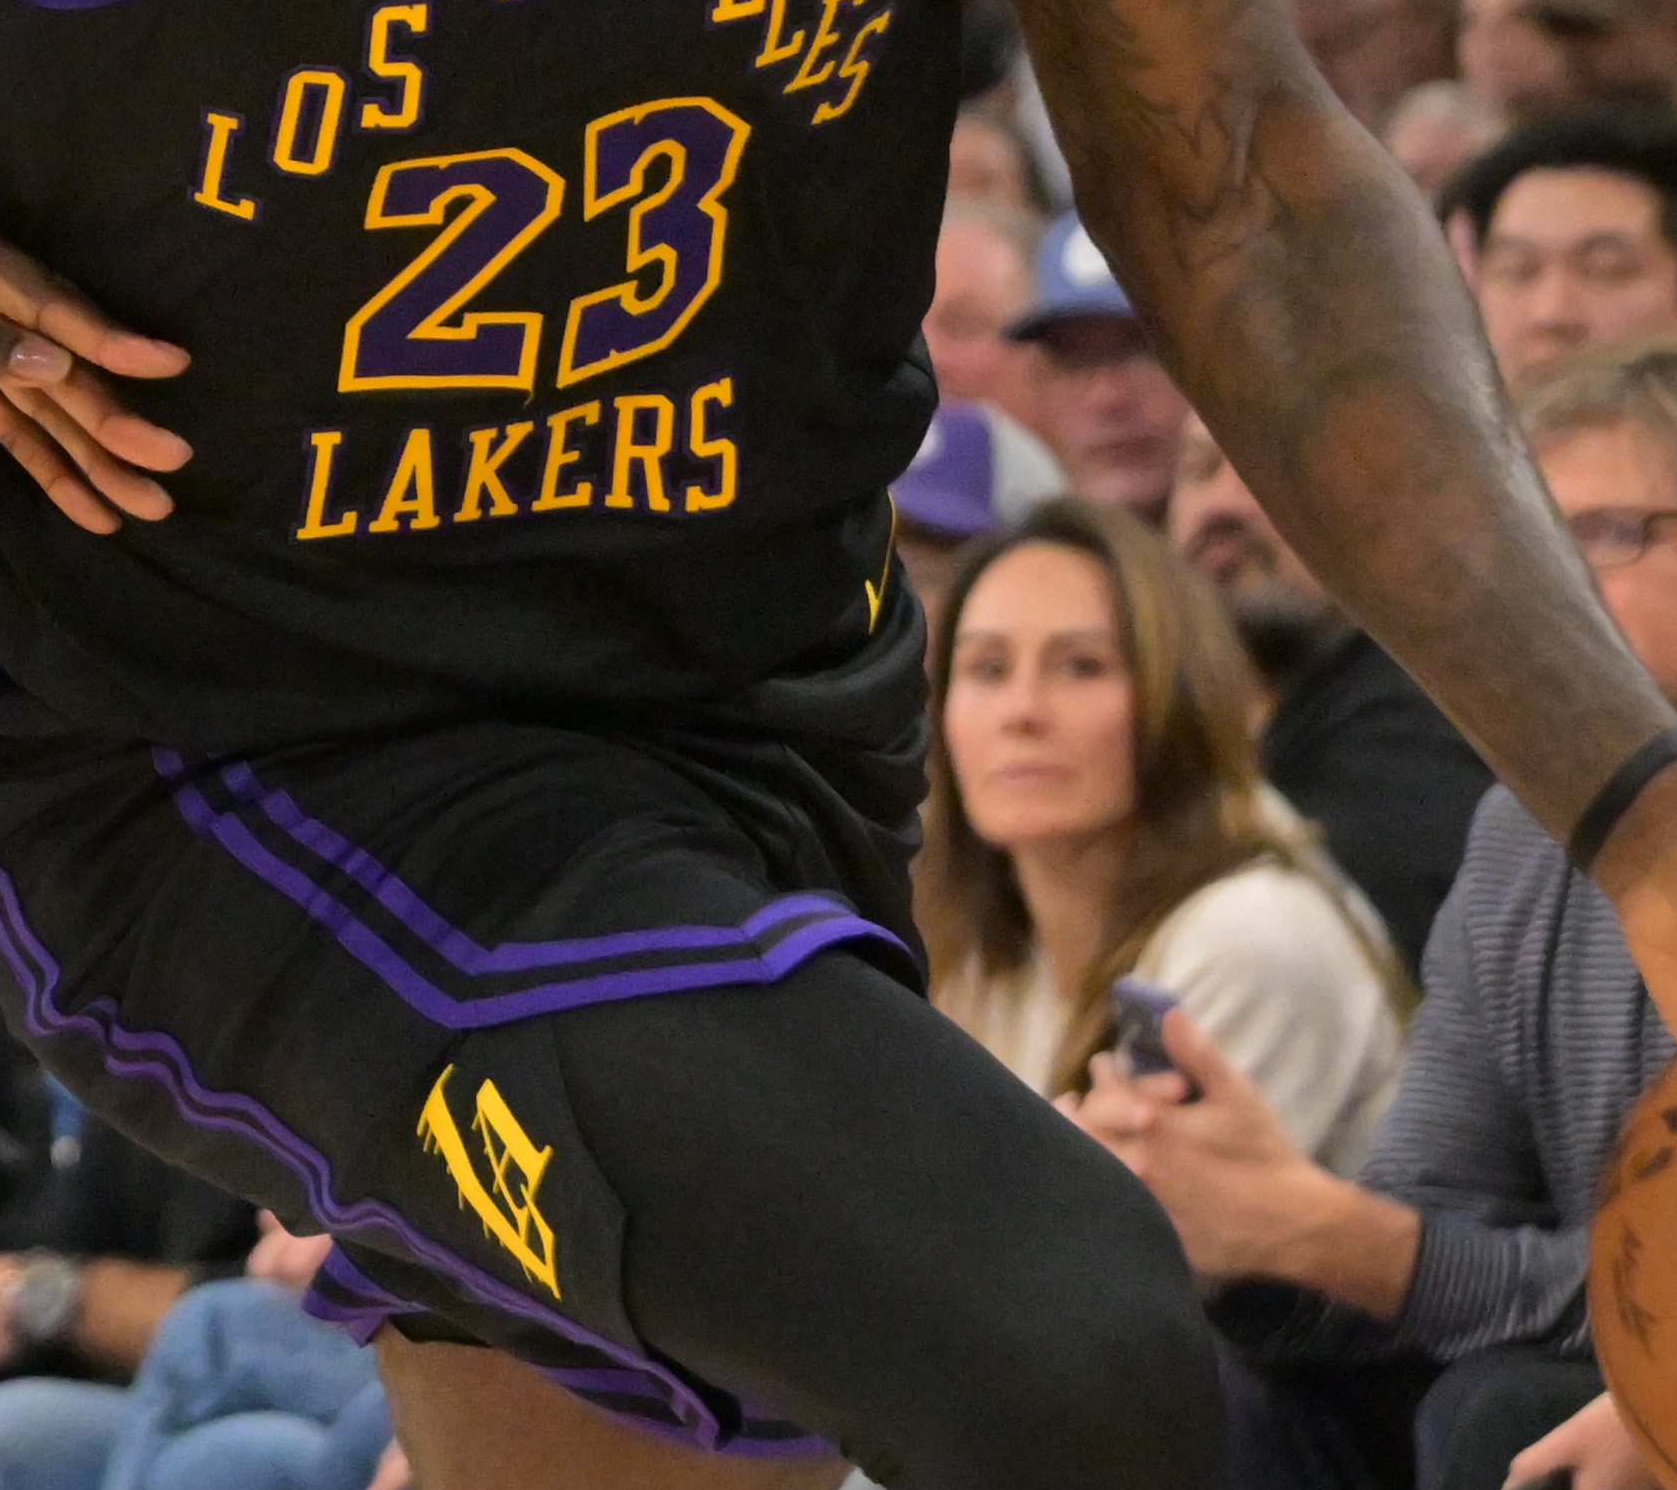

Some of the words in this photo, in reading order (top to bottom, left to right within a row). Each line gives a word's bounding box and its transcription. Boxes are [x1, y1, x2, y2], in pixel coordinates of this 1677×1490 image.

[192, 1, 430, 222] LOS
[337, 95, 752, 397] 23
[294, 375, 739, 542] LAKERS
